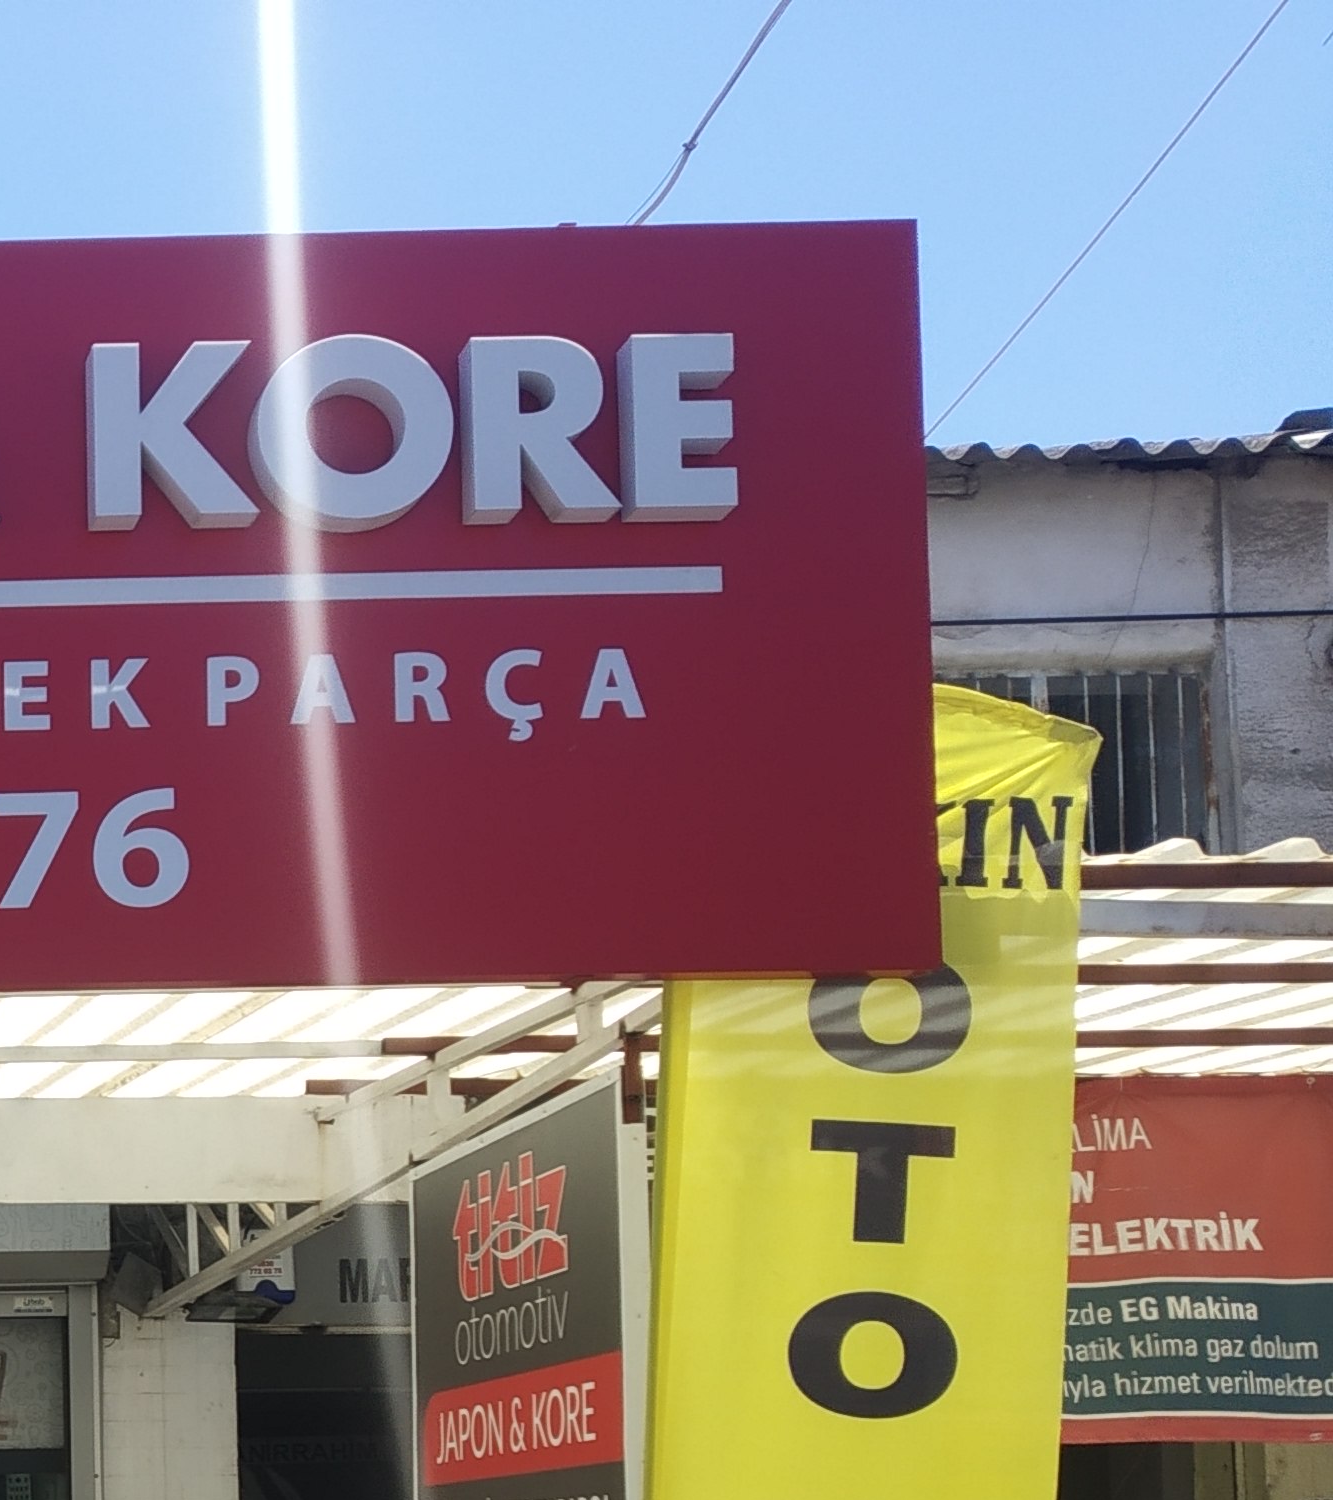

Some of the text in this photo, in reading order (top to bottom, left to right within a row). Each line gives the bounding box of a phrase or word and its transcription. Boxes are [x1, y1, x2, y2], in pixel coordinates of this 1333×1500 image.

[86, 333, 738, 533] KORE
[206, 648, 646, 741] PARÇA
[936, 796, 1073, 889] IN
[1071, 1114, 1152, 1152] LİMA
[1069, 1211, 1264, 1256] ELEKTRİK
[455, 1287, 569, 1366] otomotiv
[1121, 1297, 1158, 1322] EG
[1168, 1296, 1259, 1321] Makina
[1131, 1333, 1198, 1359] klima
[1206, 1339, 1246, 1363] gaz
[1250, 1335, 1319, 1360] dolum
[1115, 1372, 1199, 1396] hizmet
[437, 1381, 596, 1464] JAPON & KORE
